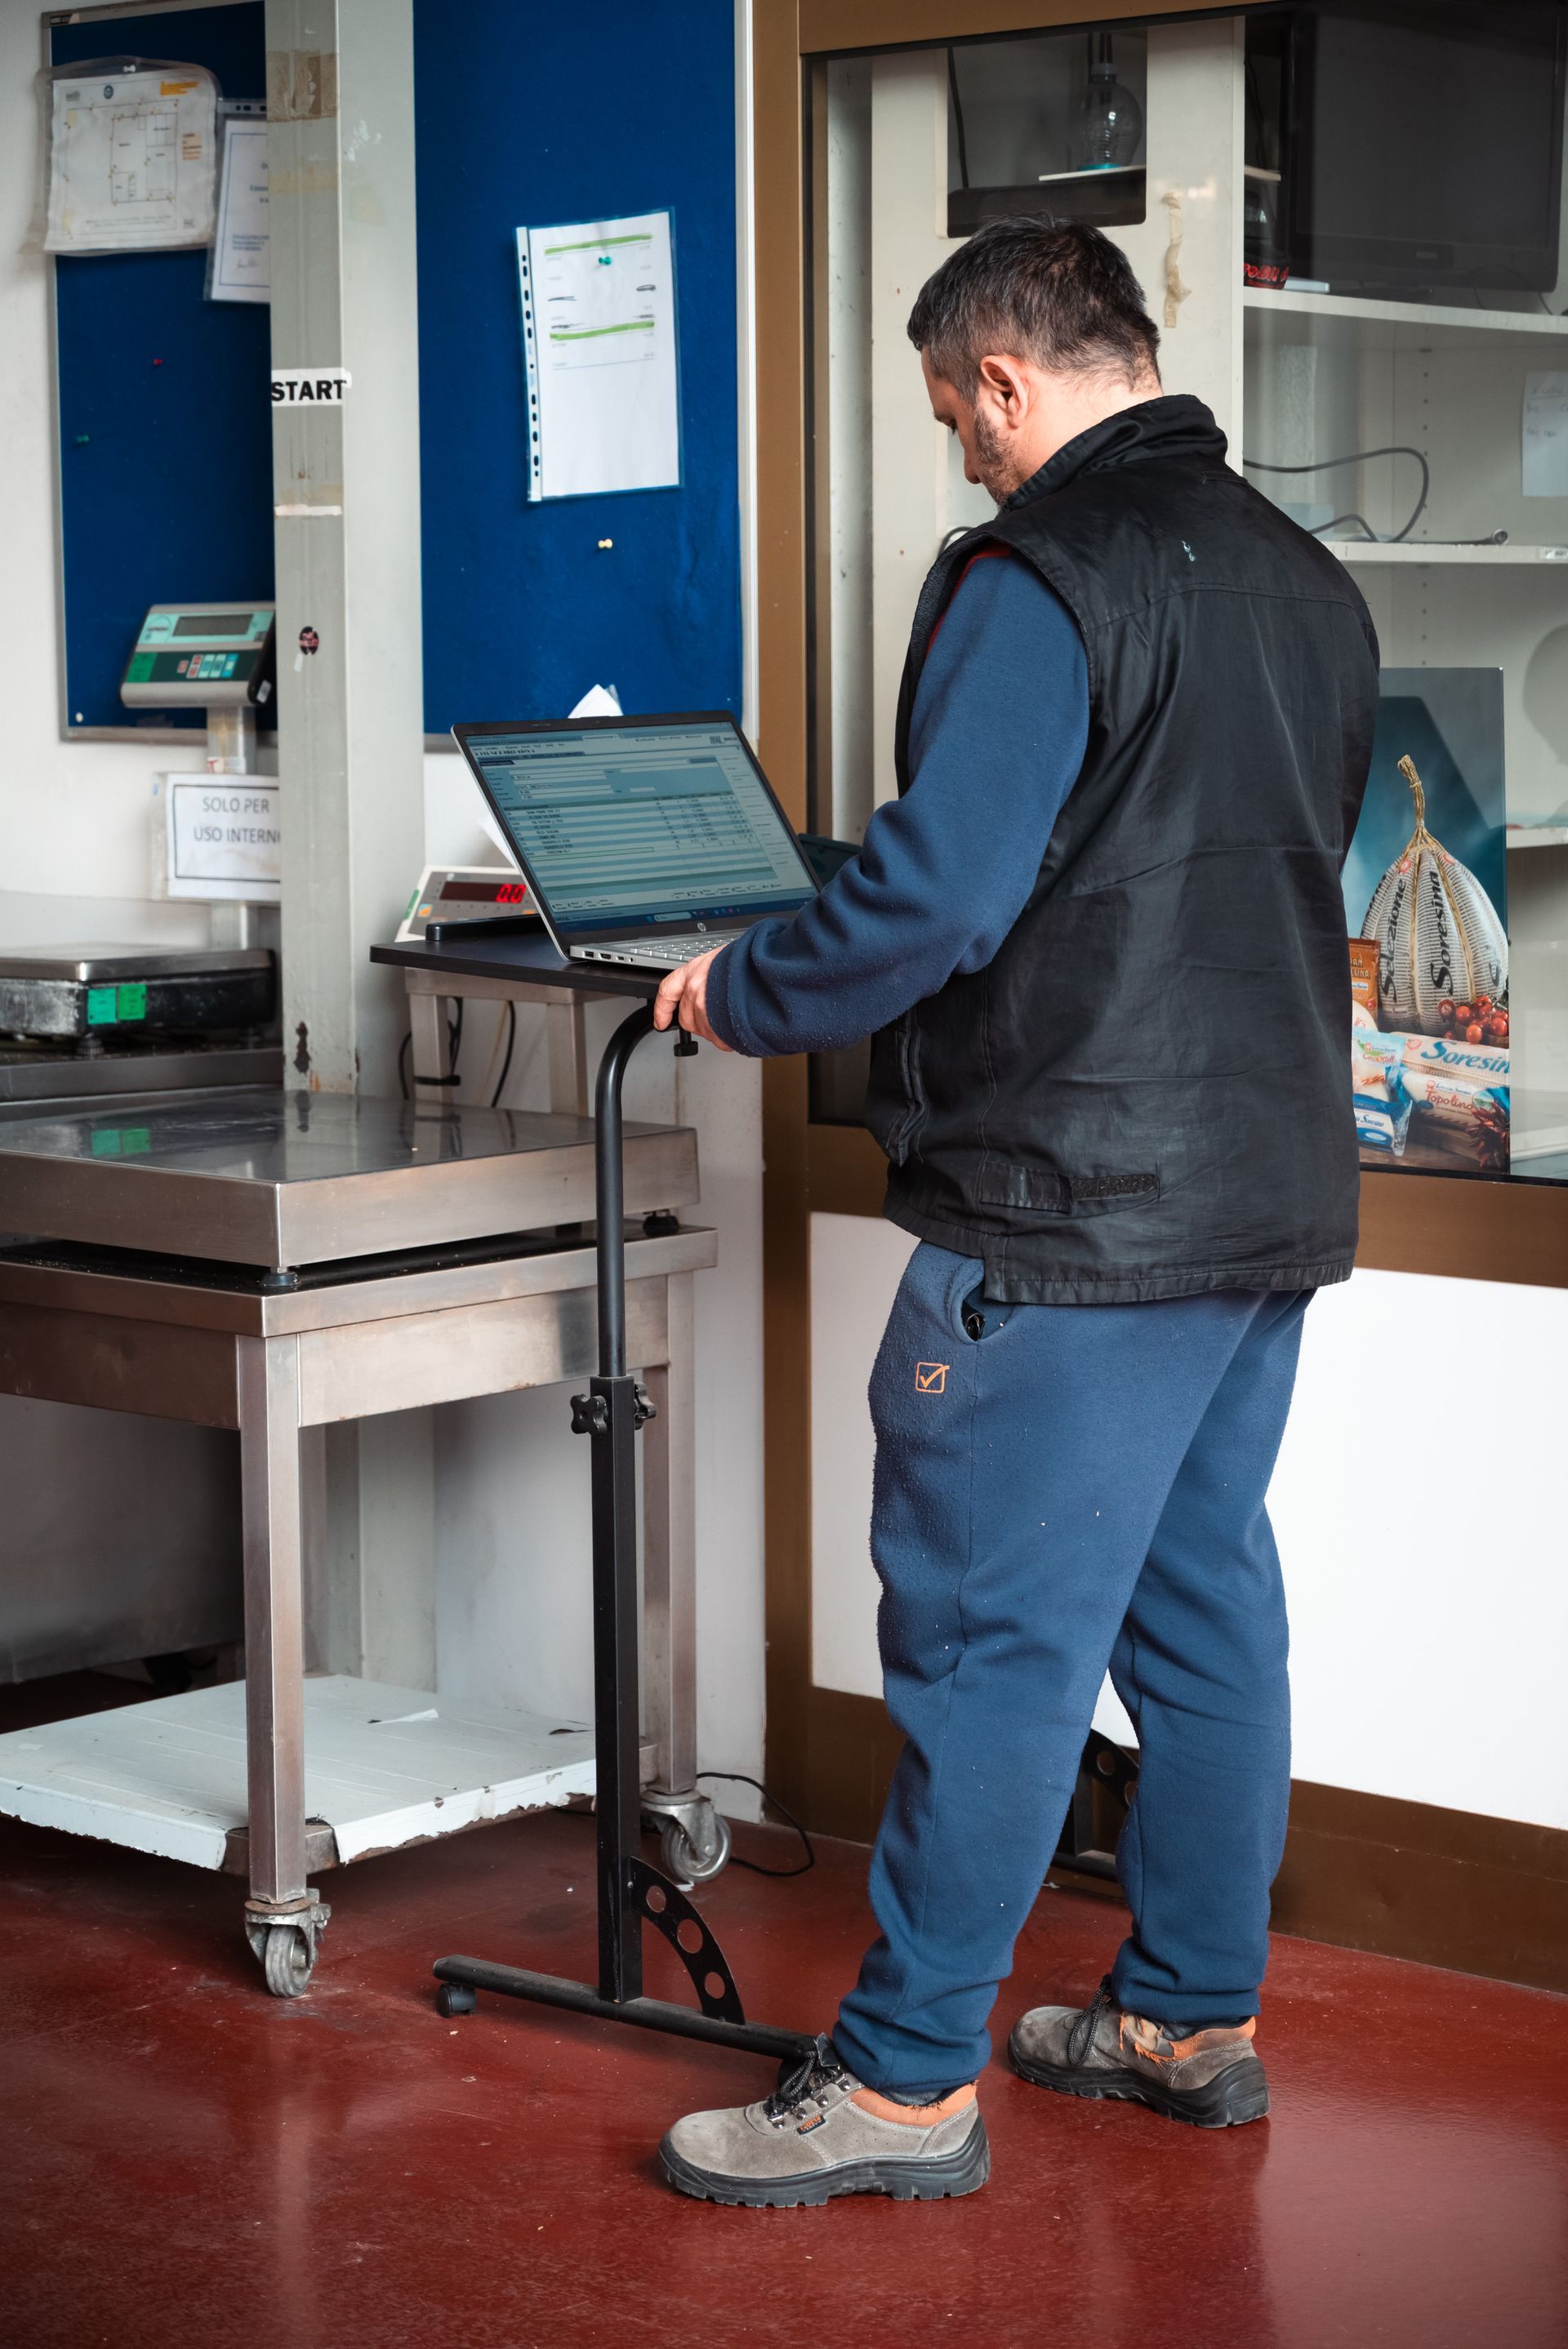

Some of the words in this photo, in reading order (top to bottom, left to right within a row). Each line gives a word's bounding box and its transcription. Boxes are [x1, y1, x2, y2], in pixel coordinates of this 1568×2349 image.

[271, 379, 347, 401] START
[202, 797, 240, 813] SOLO
[243, 798, 270, 815] PER
[194, 827, 222, 842] USO
[226, 827, 280, 844] INTERN
[1379, 879, 1406, 1004] Selezione
[1430, 871, 1454, 996] Soresina
[1351, 969, 1370, 979] SINA
[1425, 1090, 1475, 1111] Topolino
